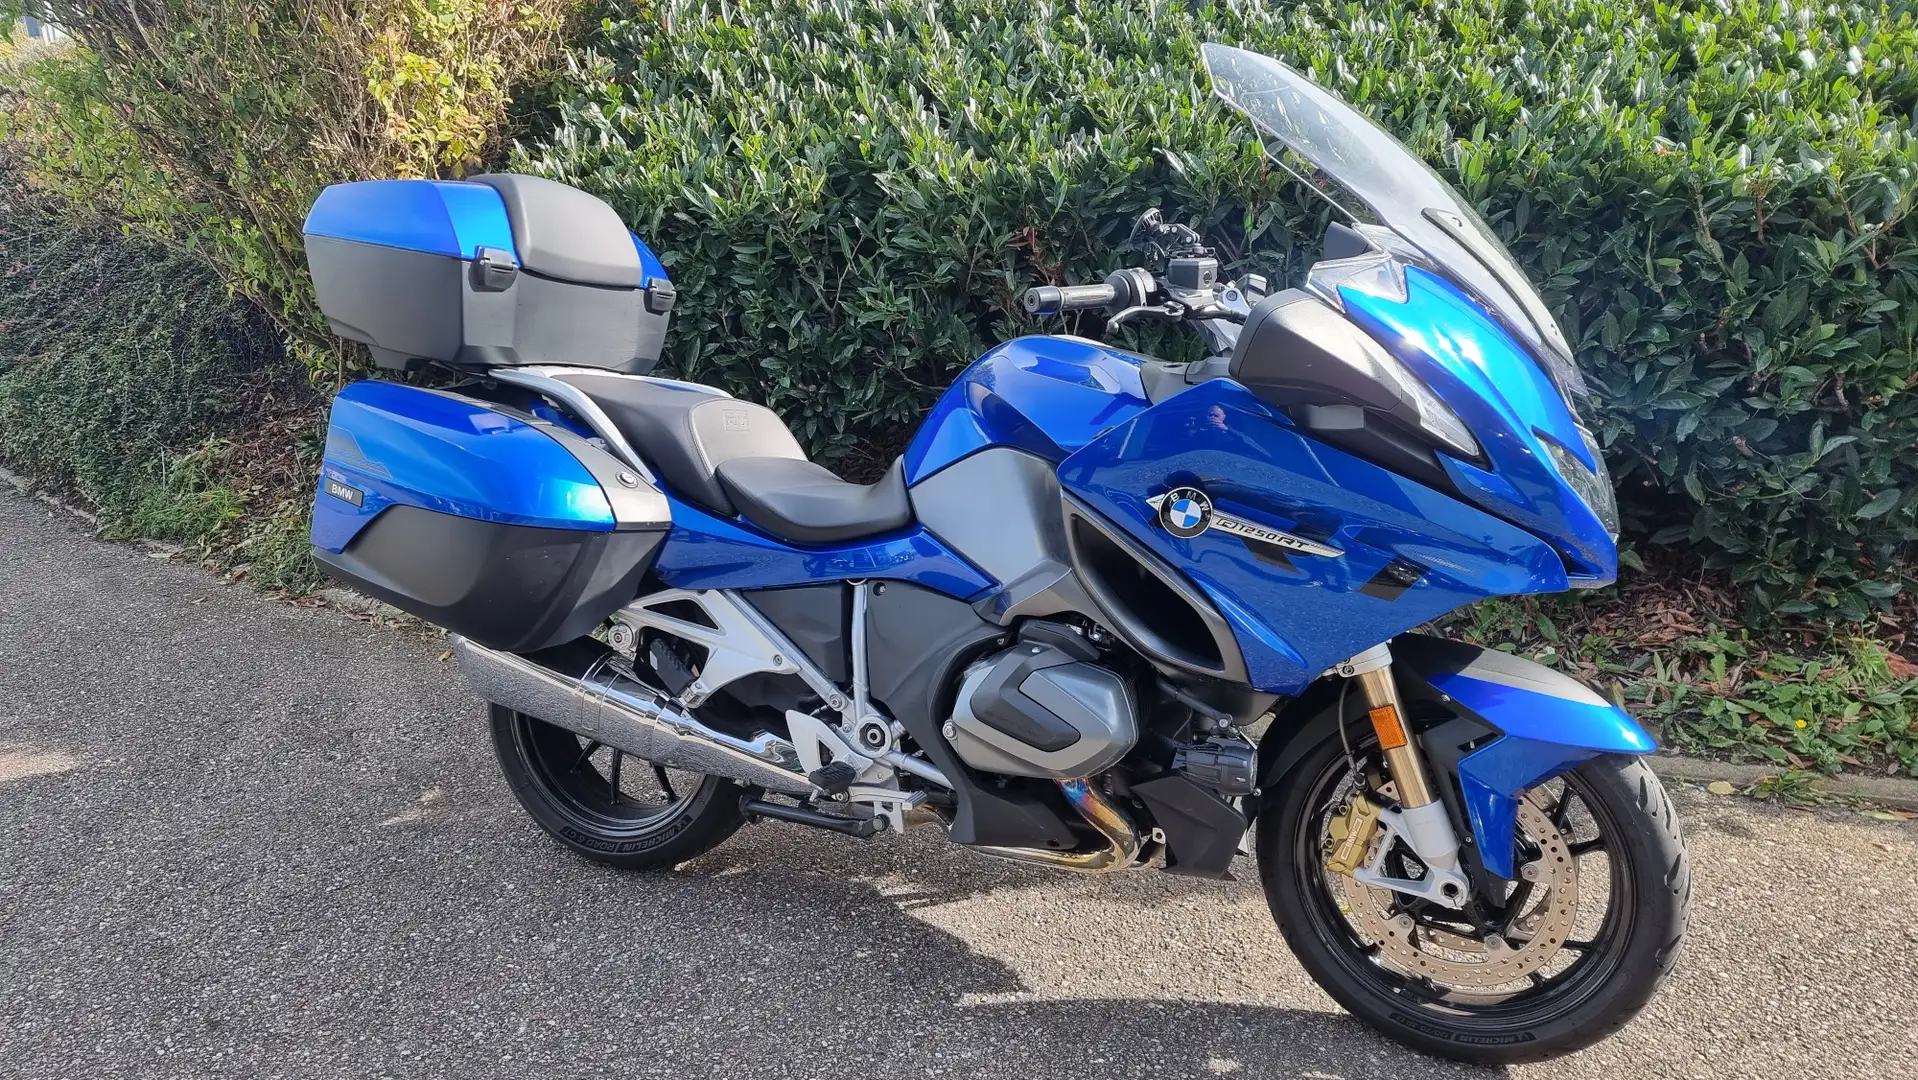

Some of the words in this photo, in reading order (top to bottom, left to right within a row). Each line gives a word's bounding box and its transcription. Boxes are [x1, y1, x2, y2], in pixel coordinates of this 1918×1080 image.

[331, 483, 354, 501] BMW
[1170, 490, 1209, 514] BMW
[585, 839, 615, 851] ROAD
[622, 828, 675, 851] MICHELIN
[1346, 828, 1358, 848] BMW
[1459, 1035, 1515, 1044] MICHELIN
